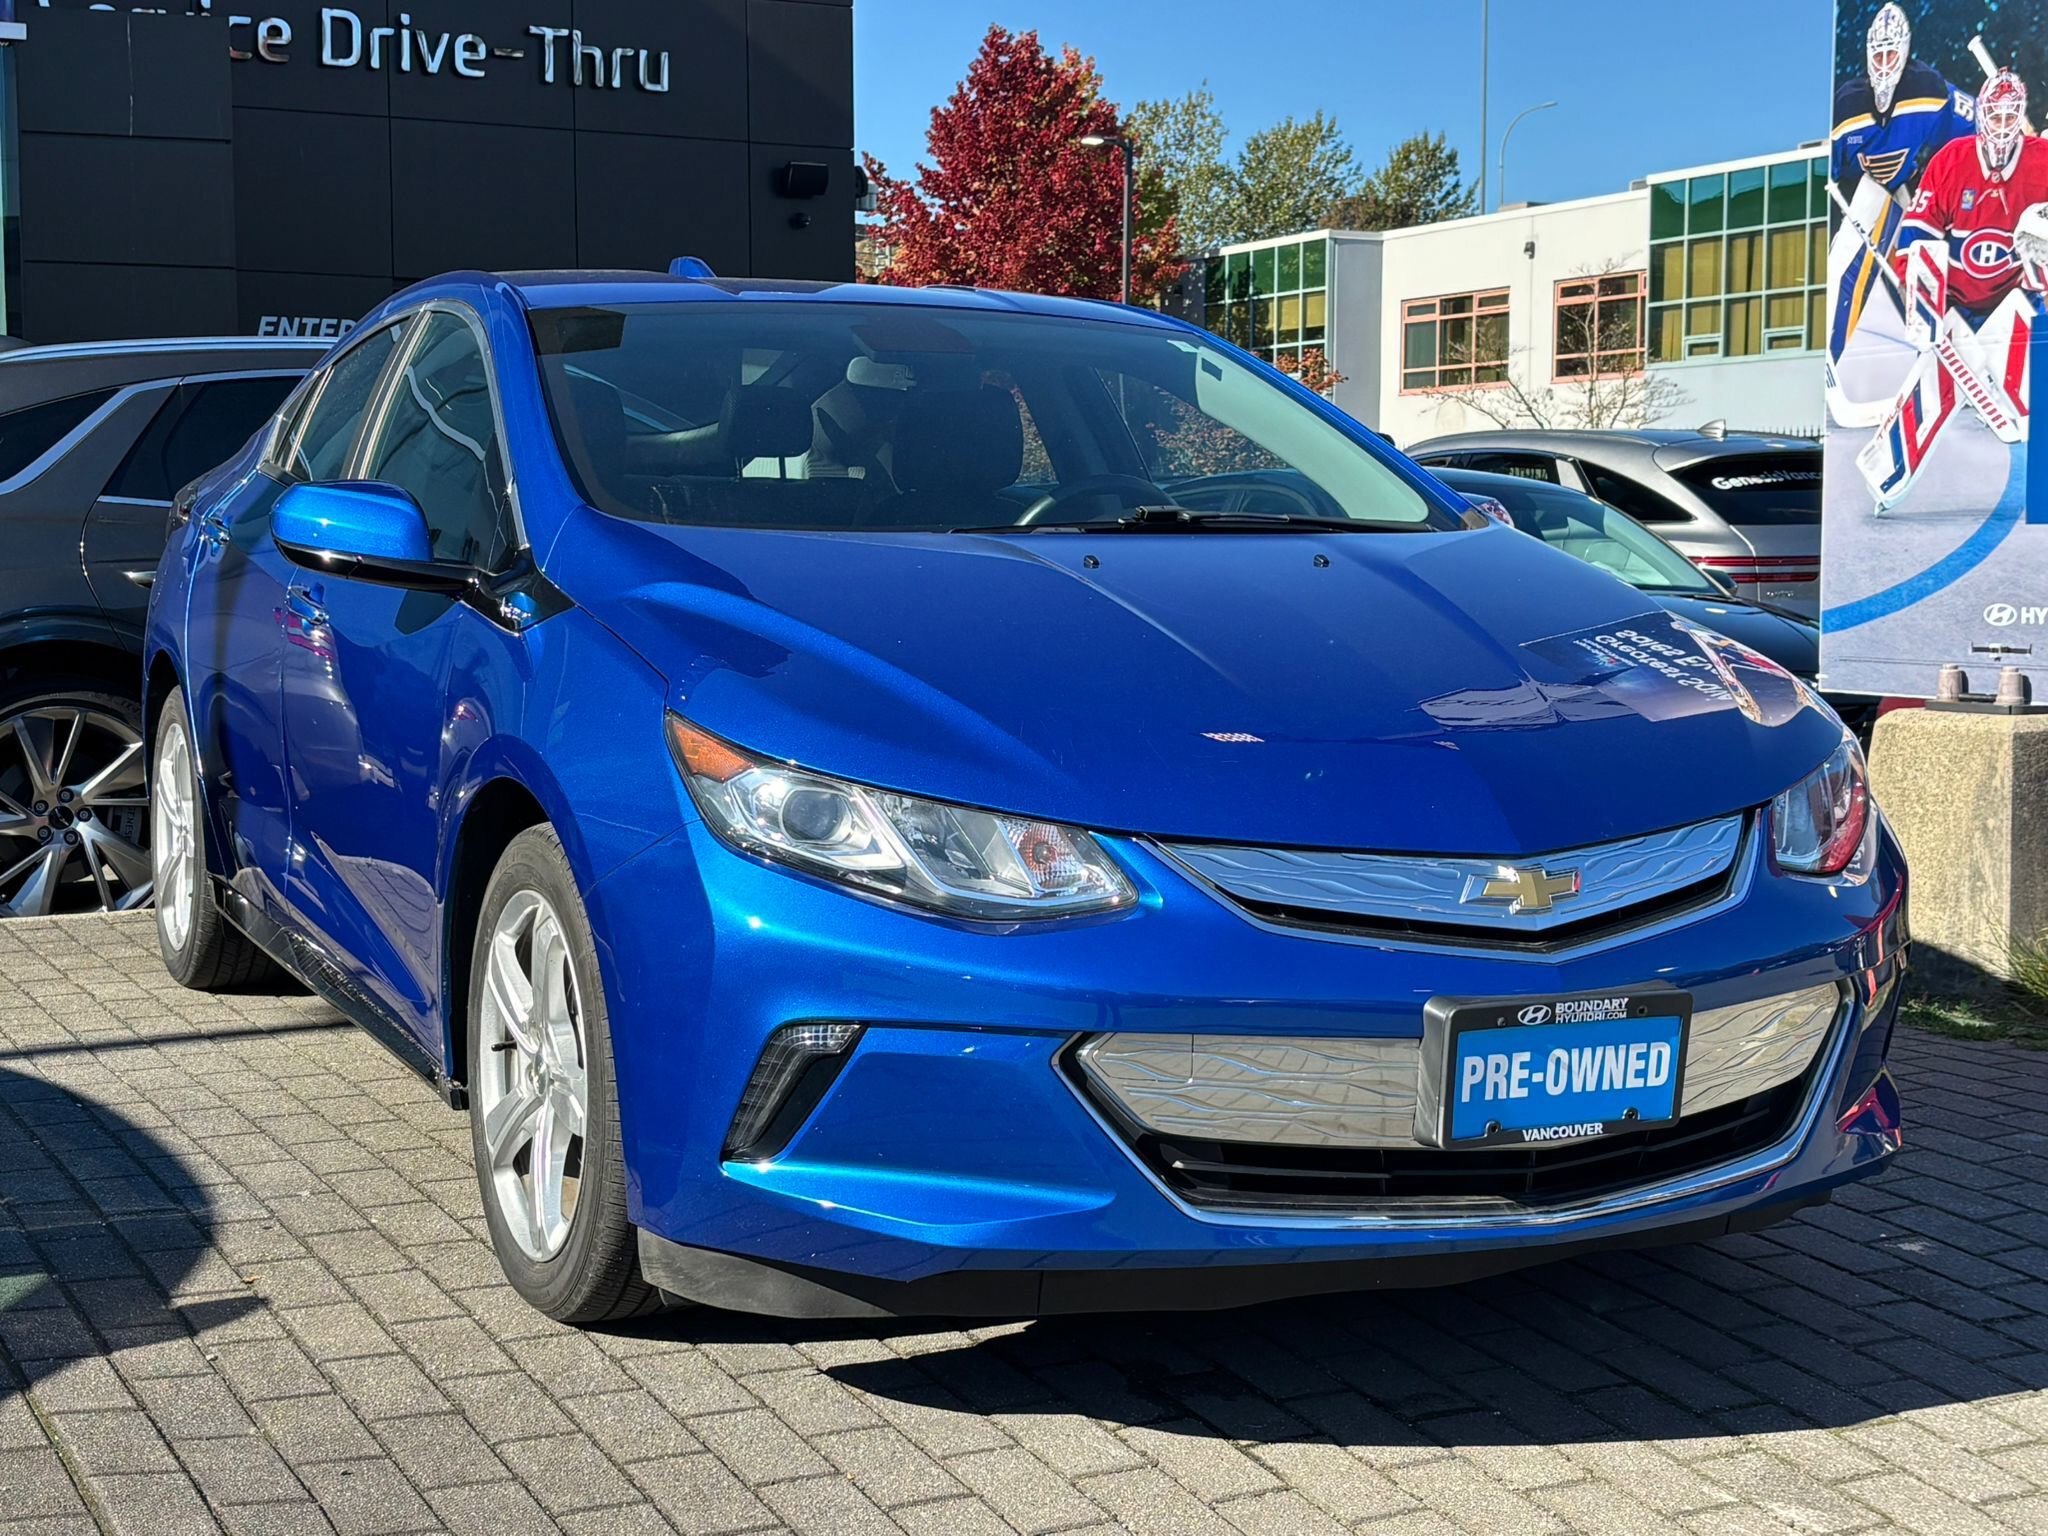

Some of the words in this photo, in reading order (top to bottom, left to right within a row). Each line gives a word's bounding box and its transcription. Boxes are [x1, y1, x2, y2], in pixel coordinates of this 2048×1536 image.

[321, 8, 670, 92] Drive-Thru
[1555, 998, 1629, 1013] BOUNDARY
[1461, 1041, 1671, 1103] PRE-OWNED
[1522, 1122, 1604, 1142] VANCOUVER
